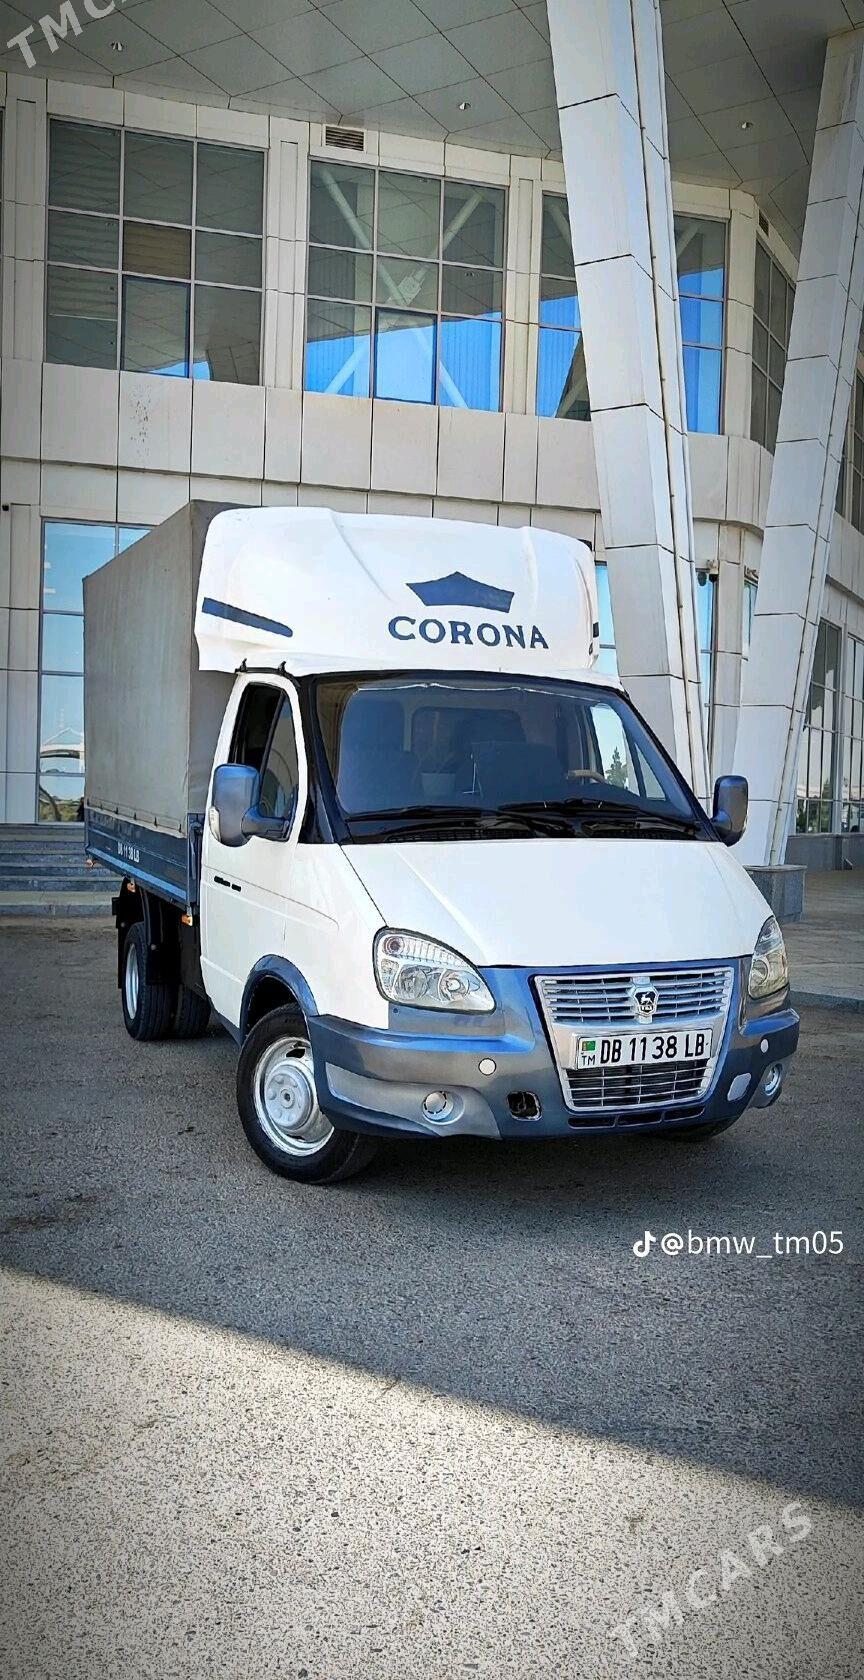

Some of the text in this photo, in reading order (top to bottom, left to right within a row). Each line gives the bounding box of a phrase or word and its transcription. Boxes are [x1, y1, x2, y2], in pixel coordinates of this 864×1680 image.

[388, 615, 549, 649] CORONA
[582, 1053, 596, 1066] TM
[600, 1039, 622, 1064] DB
[685, 1033, 705, 1057] LB
